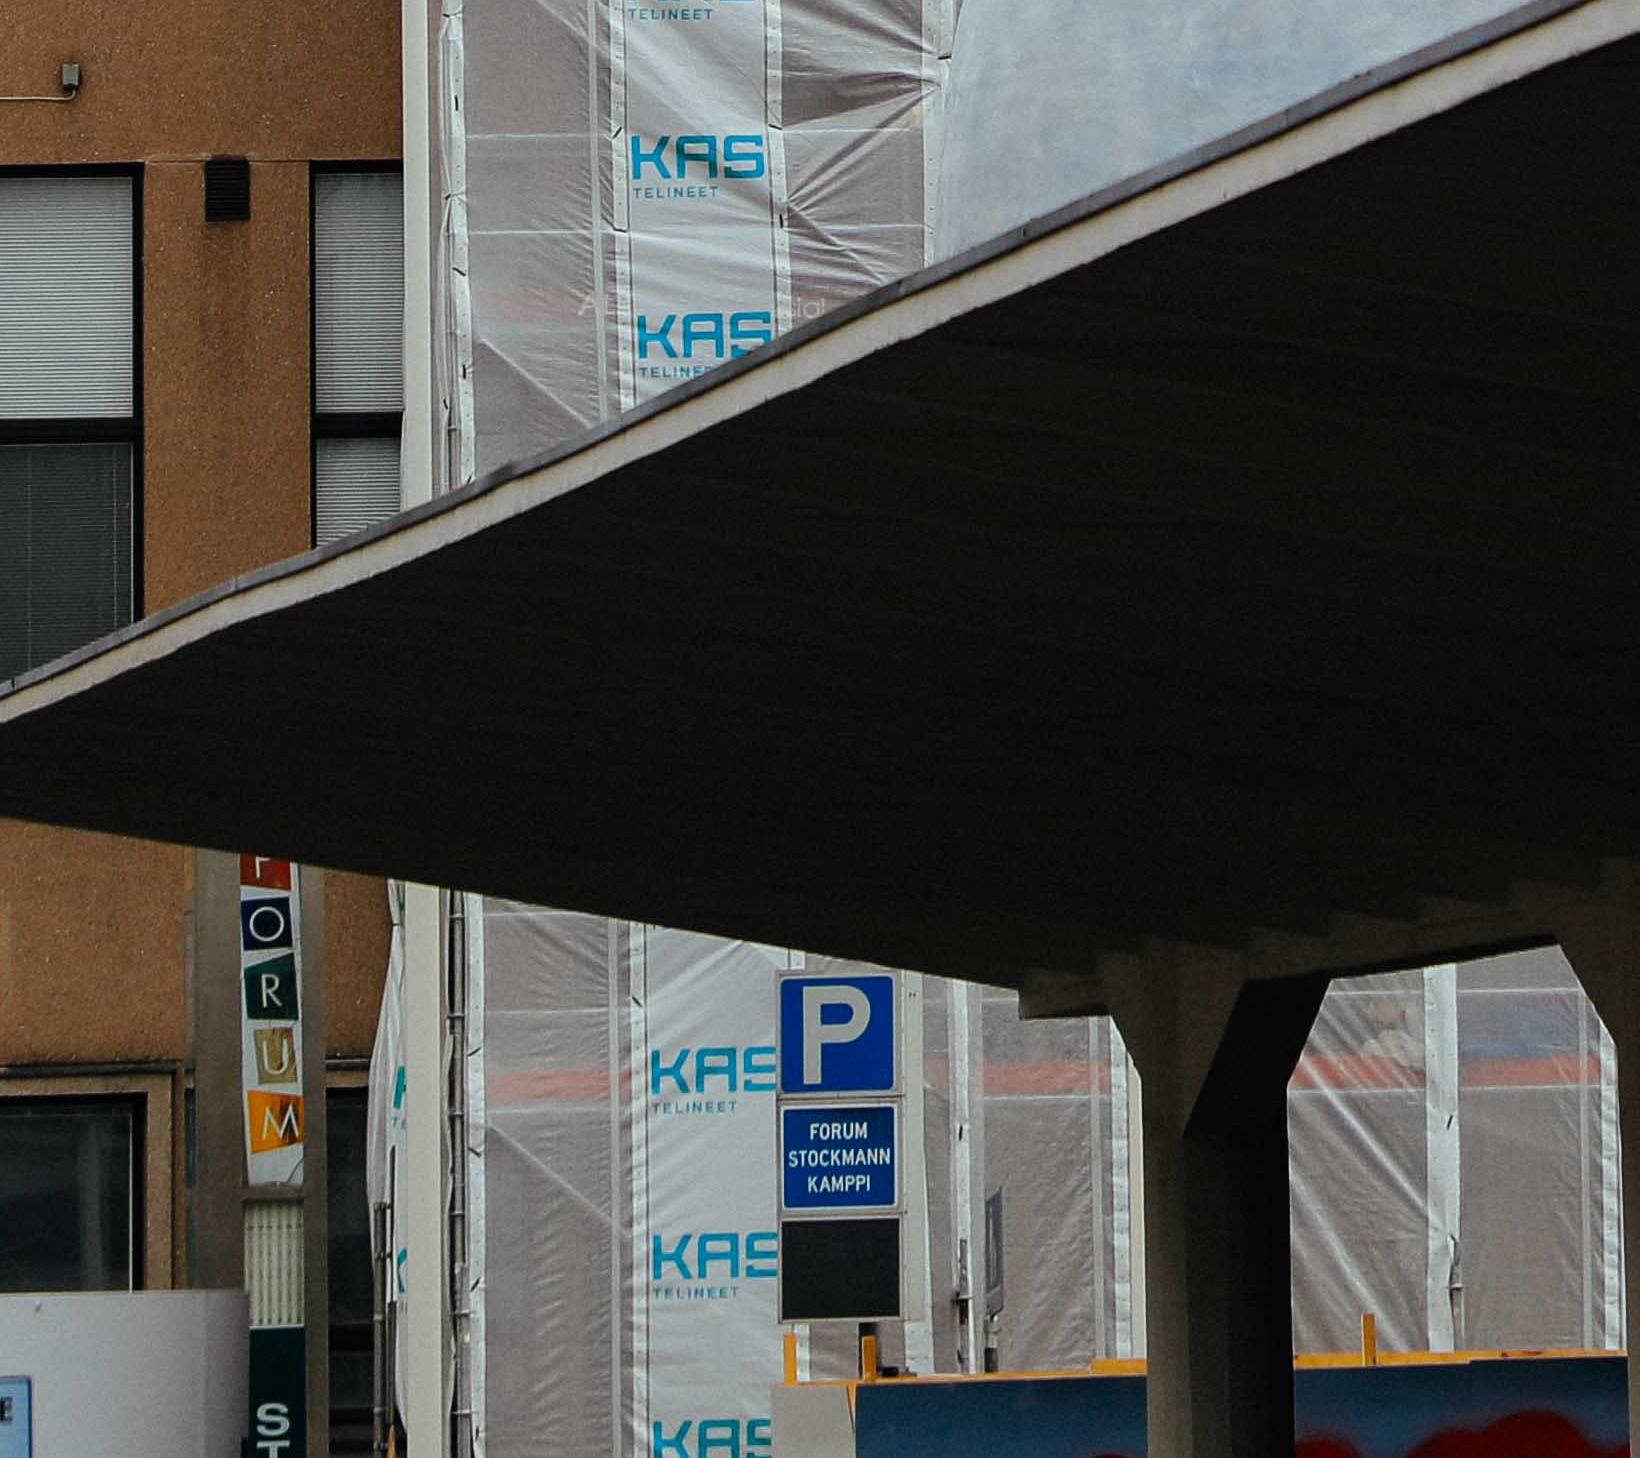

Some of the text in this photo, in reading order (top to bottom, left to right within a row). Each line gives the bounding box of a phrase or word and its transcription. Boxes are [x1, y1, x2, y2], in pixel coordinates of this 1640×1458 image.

[628, 5, 713, 20] TELINEET
[632, 135, 765, 180] KAS
[633, 184, 718, 199] TELINEET
[638, 311, 772, 359] KAS
[803, 985, 871, 1085] P
[651, 1047, 776, 1093] KAS
[652, 1099, 736, 1114] TELINEET
[810, 1122, 868, 1141] FORUM
[788, 1148, 891, 1168] STOCKMANN
[807, 1175, 871, 1193] KAMPPI
[653, 1232, 777, 1279] KAS
[654, 1285, 738, 1300] TELINEET
